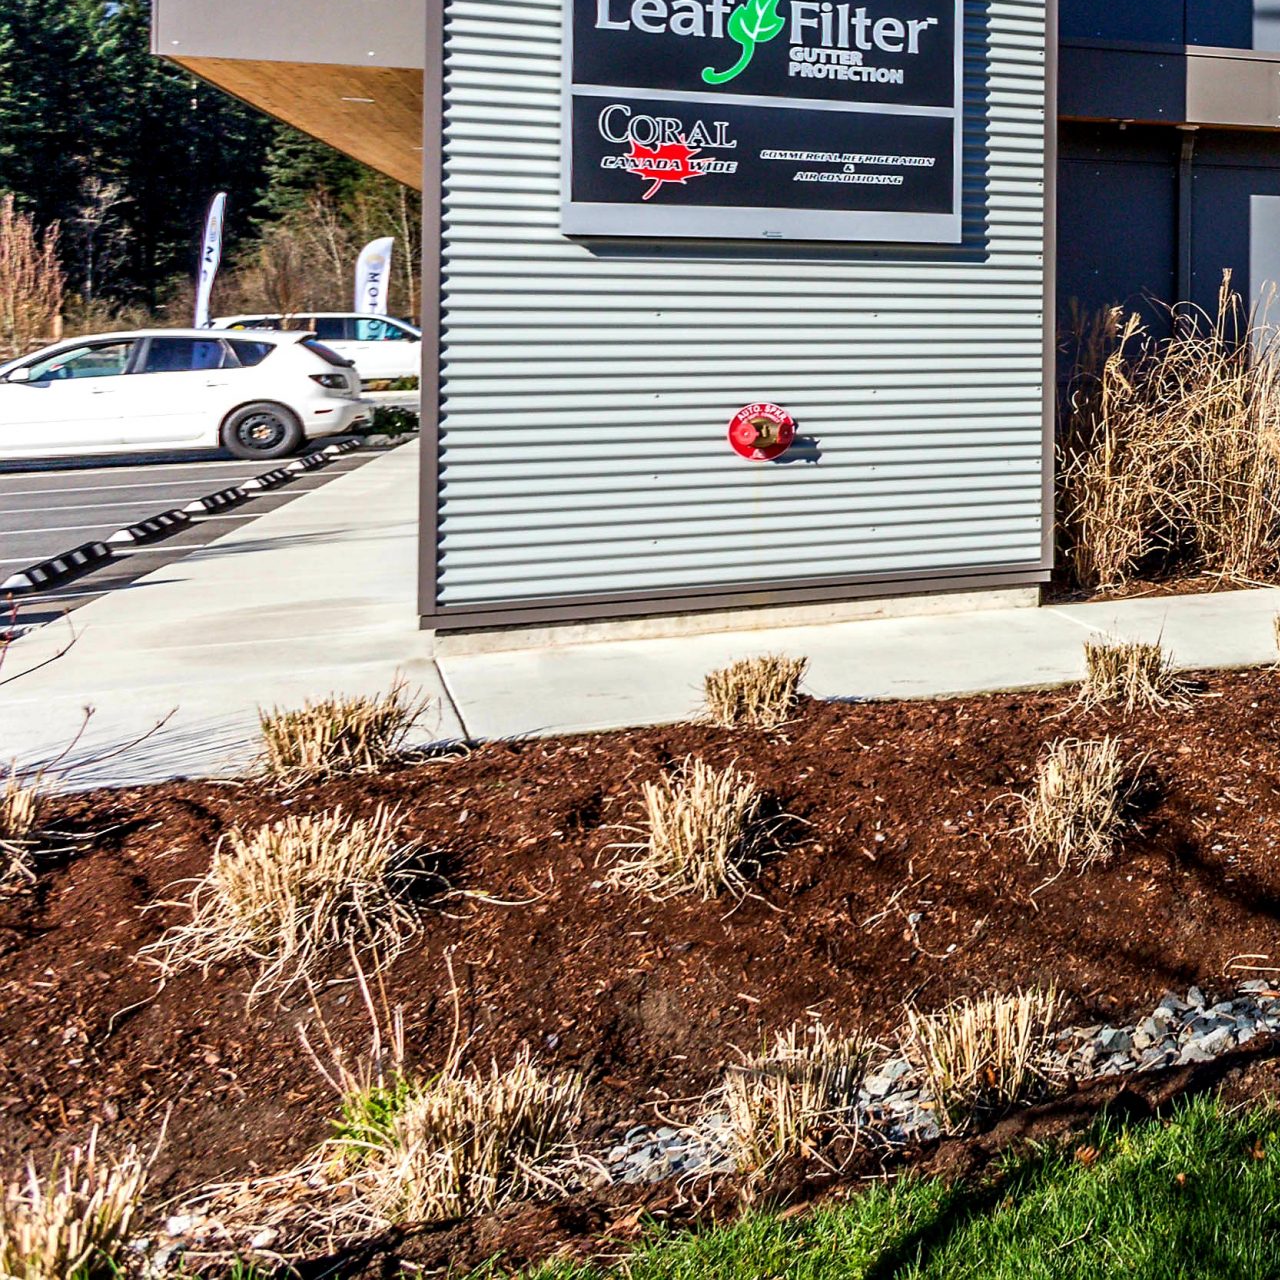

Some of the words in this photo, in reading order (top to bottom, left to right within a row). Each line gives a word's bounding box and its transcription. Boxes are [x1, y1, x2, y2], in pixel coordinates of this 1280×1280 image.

[789, 46, 864, 66] GUTTER
[788, 60, 904, 84] PROTECTION
[598, 104, 738, 149] CORAL
[600, 156, 683, 171] CANADA
[688, 160, 739, 174] WIDE
[760, 149, 842, 163] COMMERCIAL
[842, 153, 936, 167] REFRIGERATION
[843, 163, 855, 173] &
[793, 171, 819, 182] AIR
[819, 173, 904, 185] CONDITIONING
